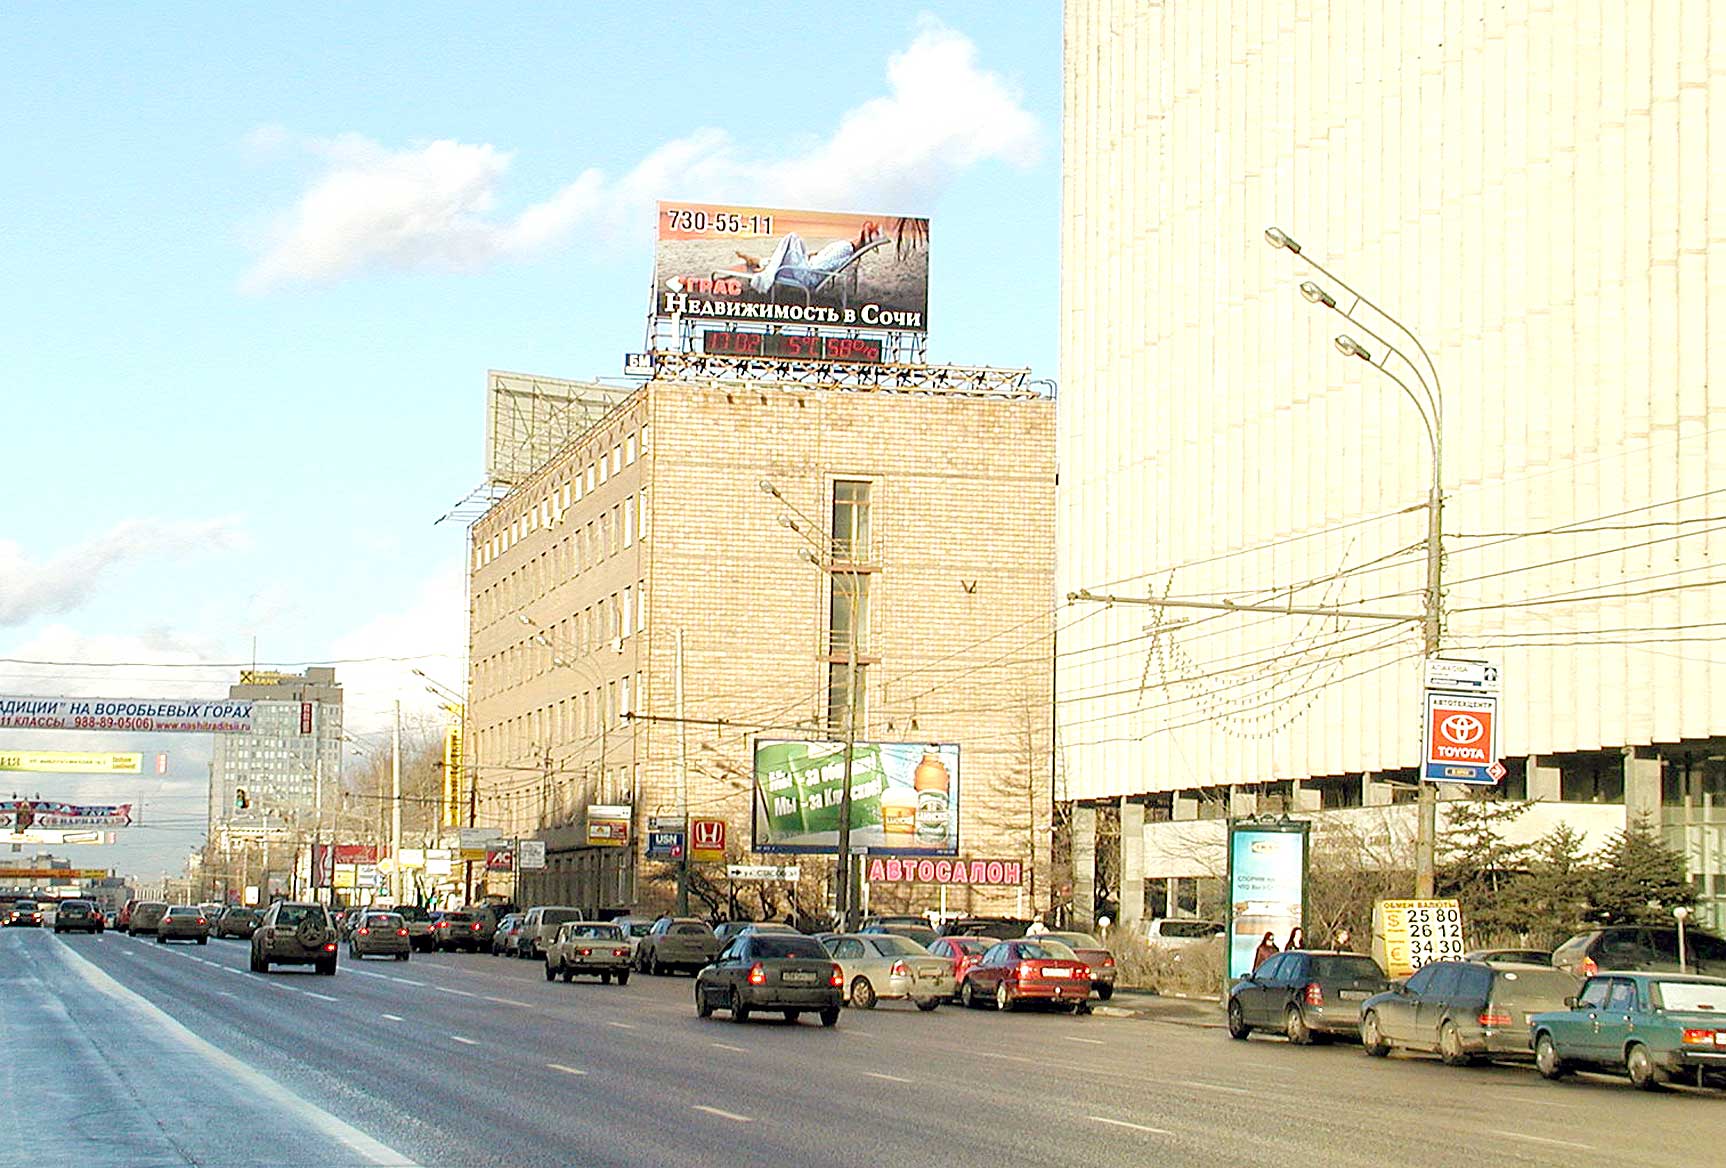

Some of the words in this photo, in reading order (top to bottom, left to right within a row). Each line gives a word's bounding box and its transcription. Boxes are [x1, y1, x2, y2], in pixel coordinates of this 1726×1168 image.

[668, 210, 771, 234] 730-55-11
[664, 292, 840, 322] Недвижимость
[843, 308, 857, 323] в
[860, 303, 921, 327] Сочи
[69, 702, 91, 715] НА
[94, 703, 201, 718] ВОРОБЬЕВЫХ
[203, 704, 252, 718] ГОРАХ
[1437, 745, 1485, 760] TOYOTA
[774, 795, 798, 817] Мы
[869, 858, 1022, 884] АВТОСАЛОН
[1407, 909, 1430, 923] 25
[1436, 908, 1458, 923] 80
[1409, 924, 1433, 938] 26
[1438, 924, 1460, 938] 12
[1411, 940, 1434, 954] 34
[1440, 940, 1462, 954] 30
